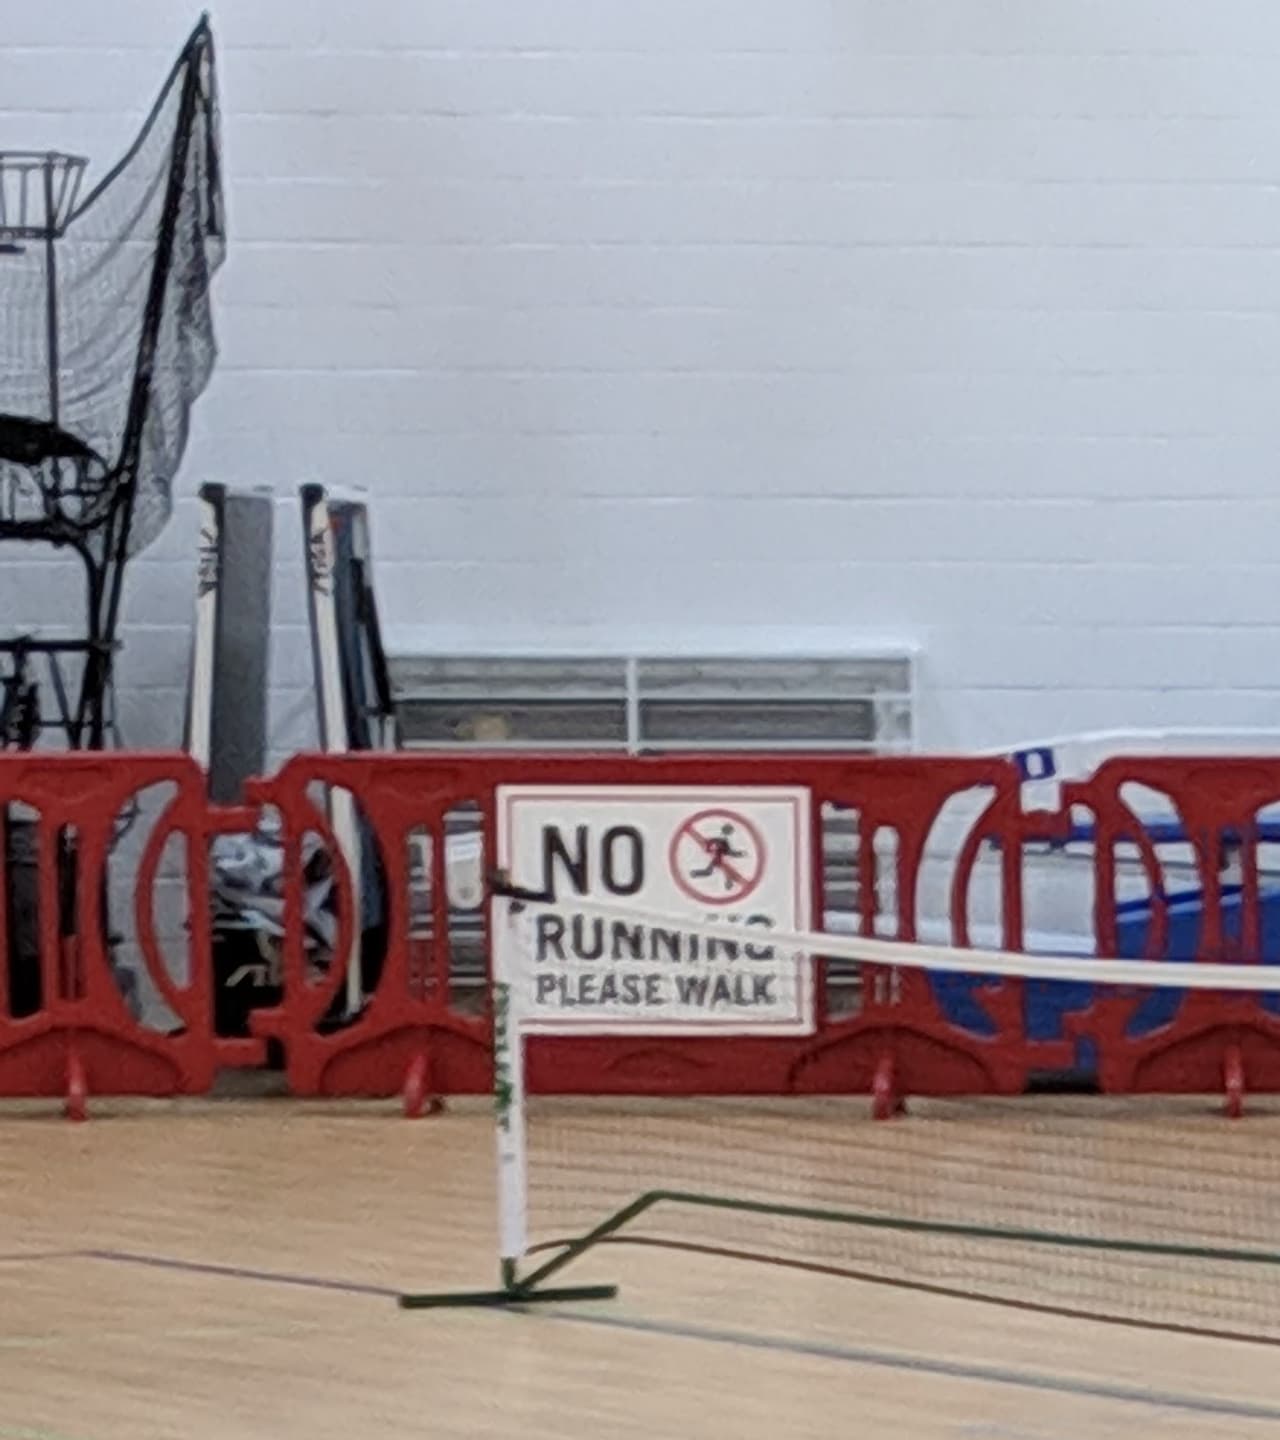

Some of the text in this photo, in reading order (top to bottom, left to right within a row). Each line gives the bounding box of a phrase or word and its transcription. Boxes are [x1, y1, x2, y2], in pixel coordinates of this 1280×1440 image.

[541, 824, 645, 898] NO
[536, 912, 776, 962] RUNNING
[535, 972, 778, 1007] PLEASE WALK
